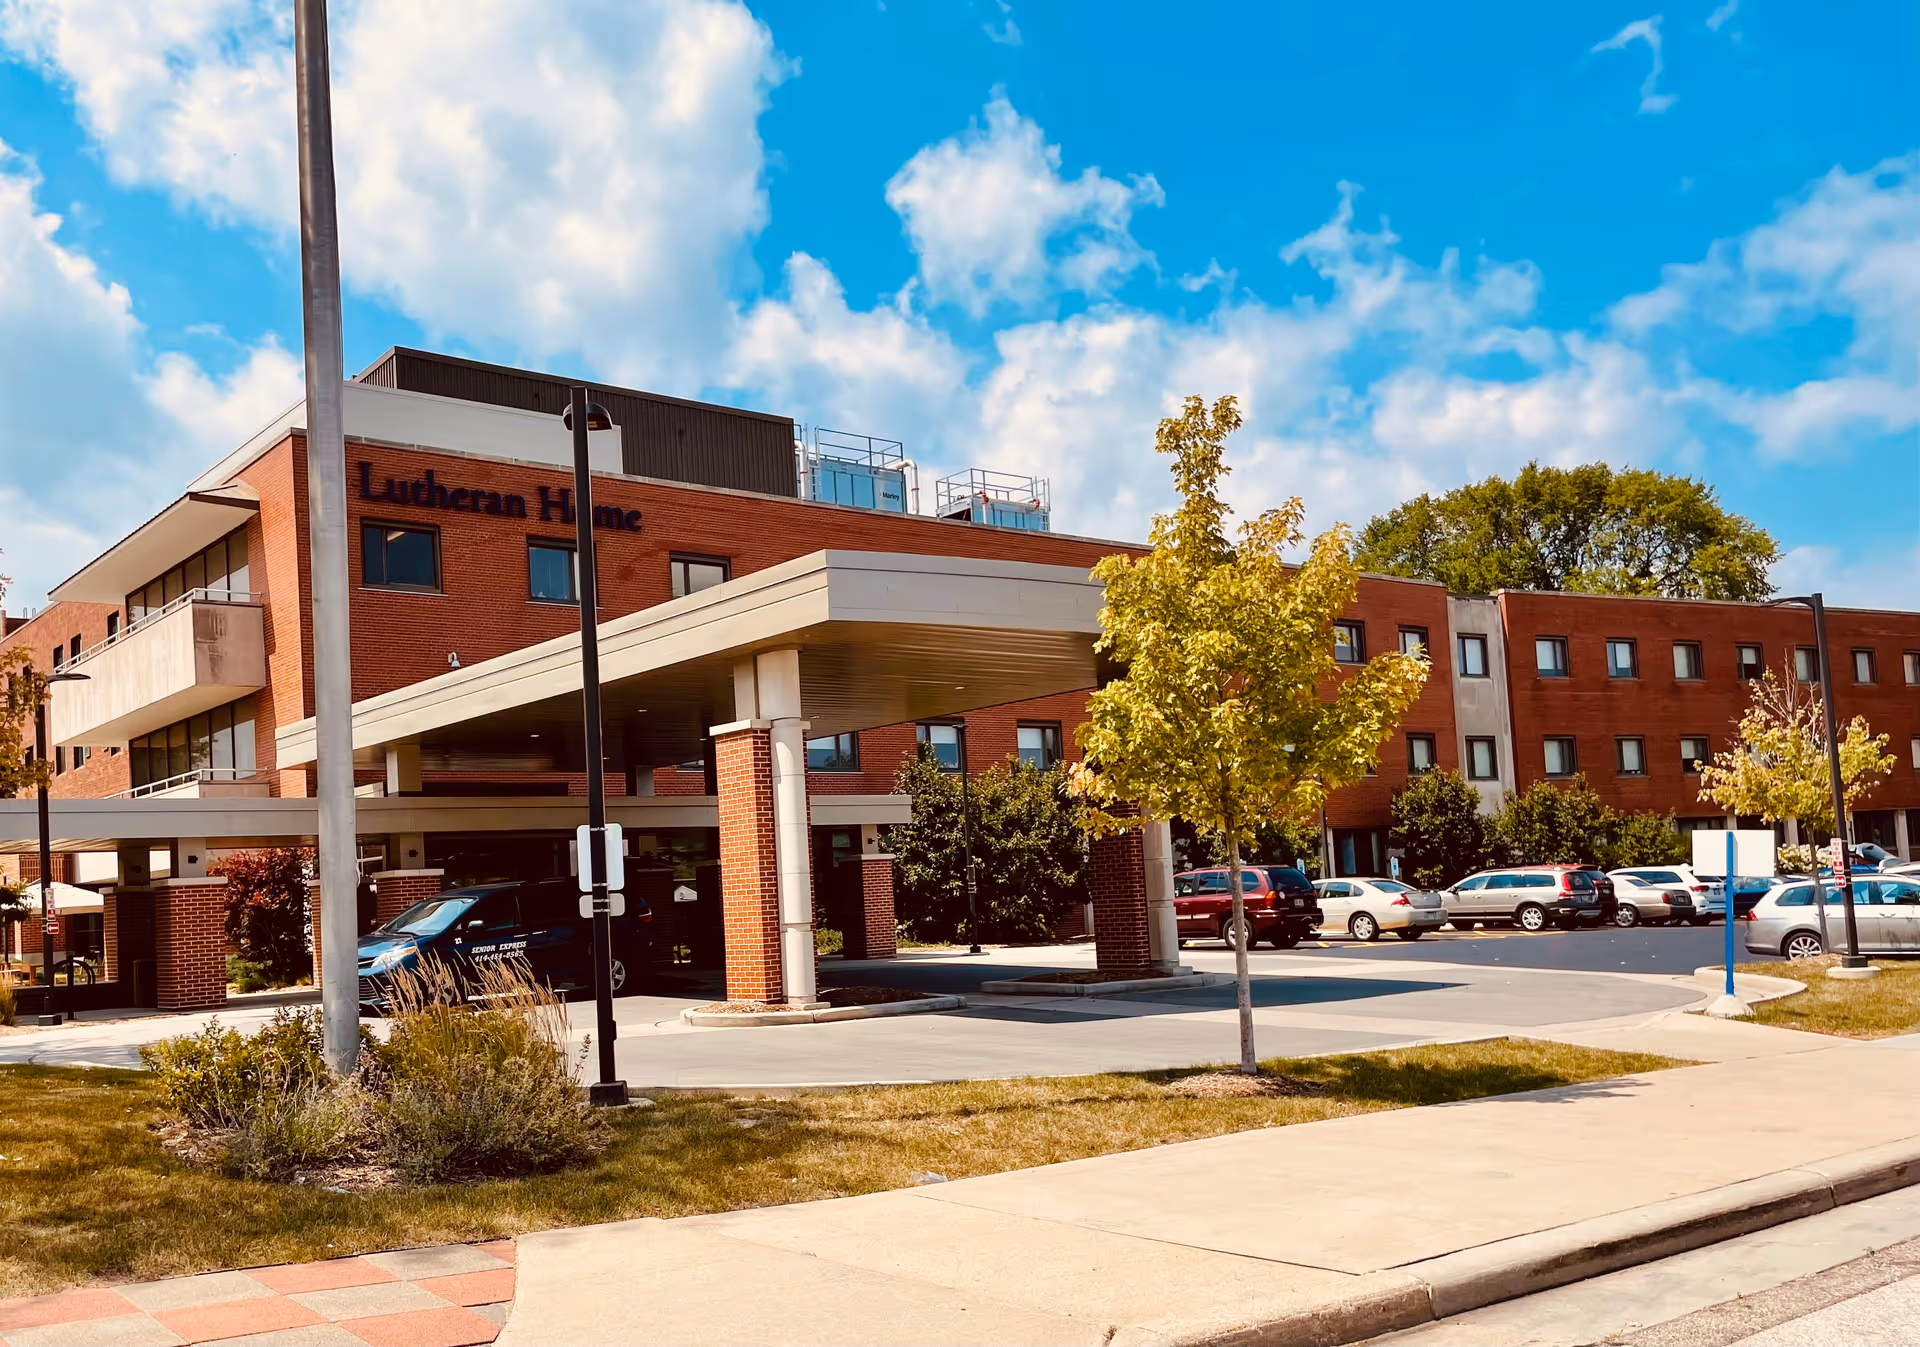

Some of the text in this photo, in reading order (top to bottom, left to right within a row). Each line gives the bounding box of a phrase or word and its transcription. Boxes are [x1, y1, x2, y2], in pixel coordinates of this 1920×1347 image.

[357, 461, 643, 531] Lutheran Hme
[471, 941, 527, 954] SENIOR EXPRESS
